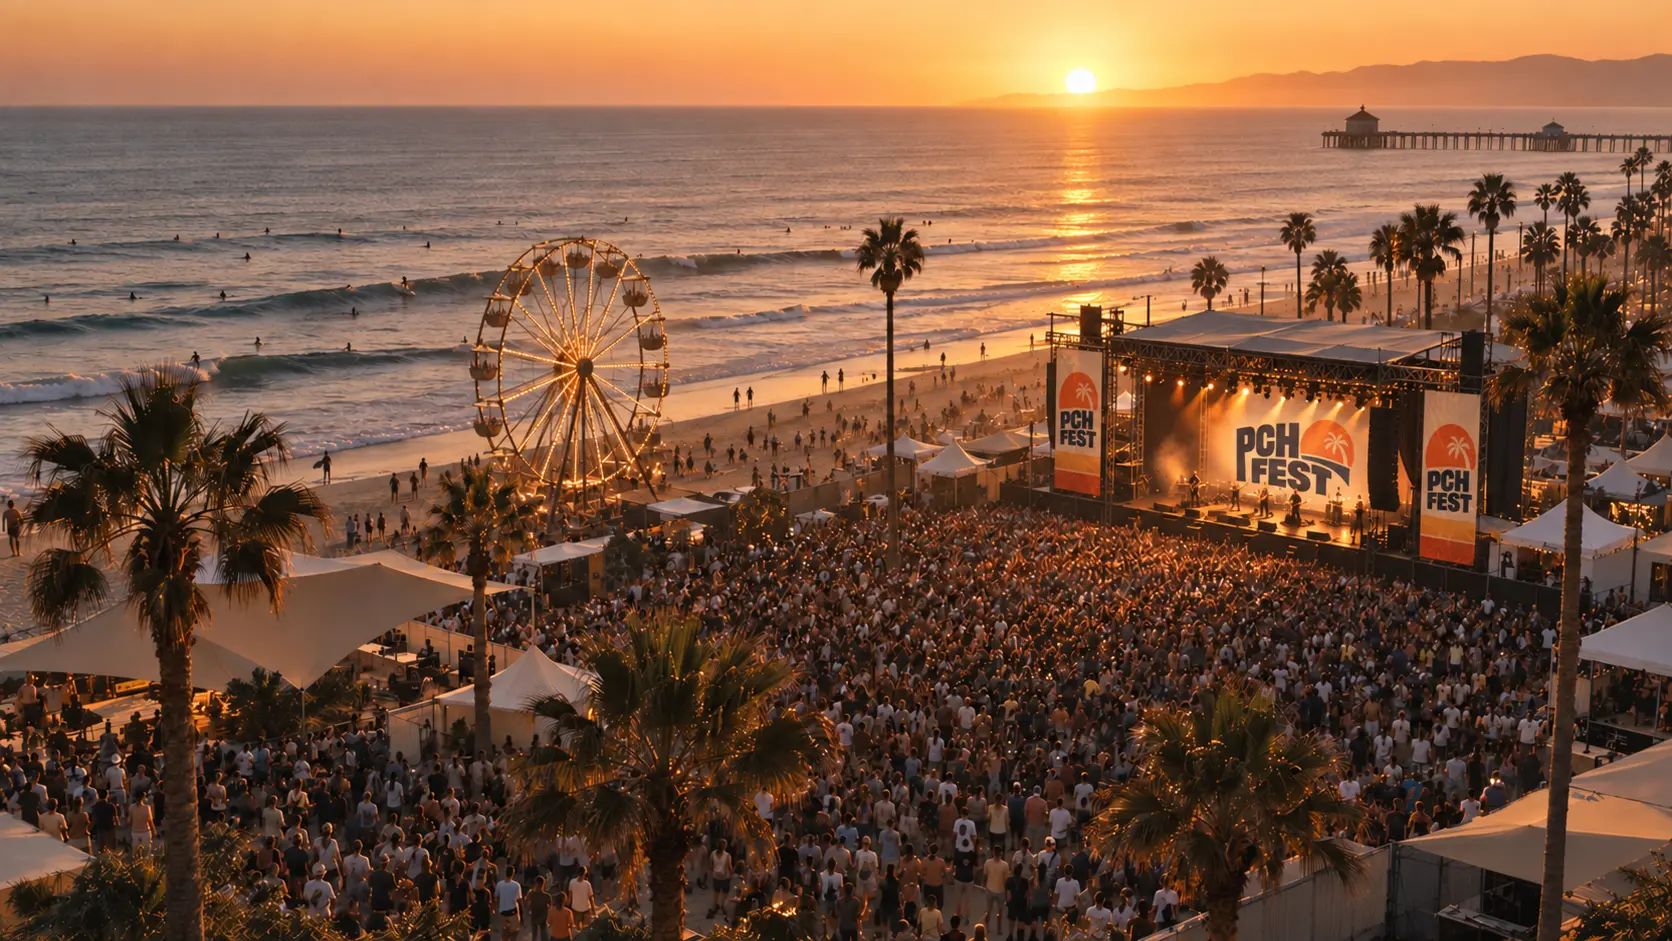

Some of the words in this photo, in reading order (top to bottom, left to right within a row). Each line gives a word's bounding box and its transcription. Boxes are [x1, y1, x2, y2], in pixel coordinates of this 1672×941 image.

[1060, 410, 1094, 430] PCH
[1060, 429, 1096, 448] FEST
[1236, 422, 1300, 482] PCH
[1251, 457, 1332, 496] FEST
[1428, 469, 1470, 492] PCH
[1427, 492, 1472, 513] FEST
